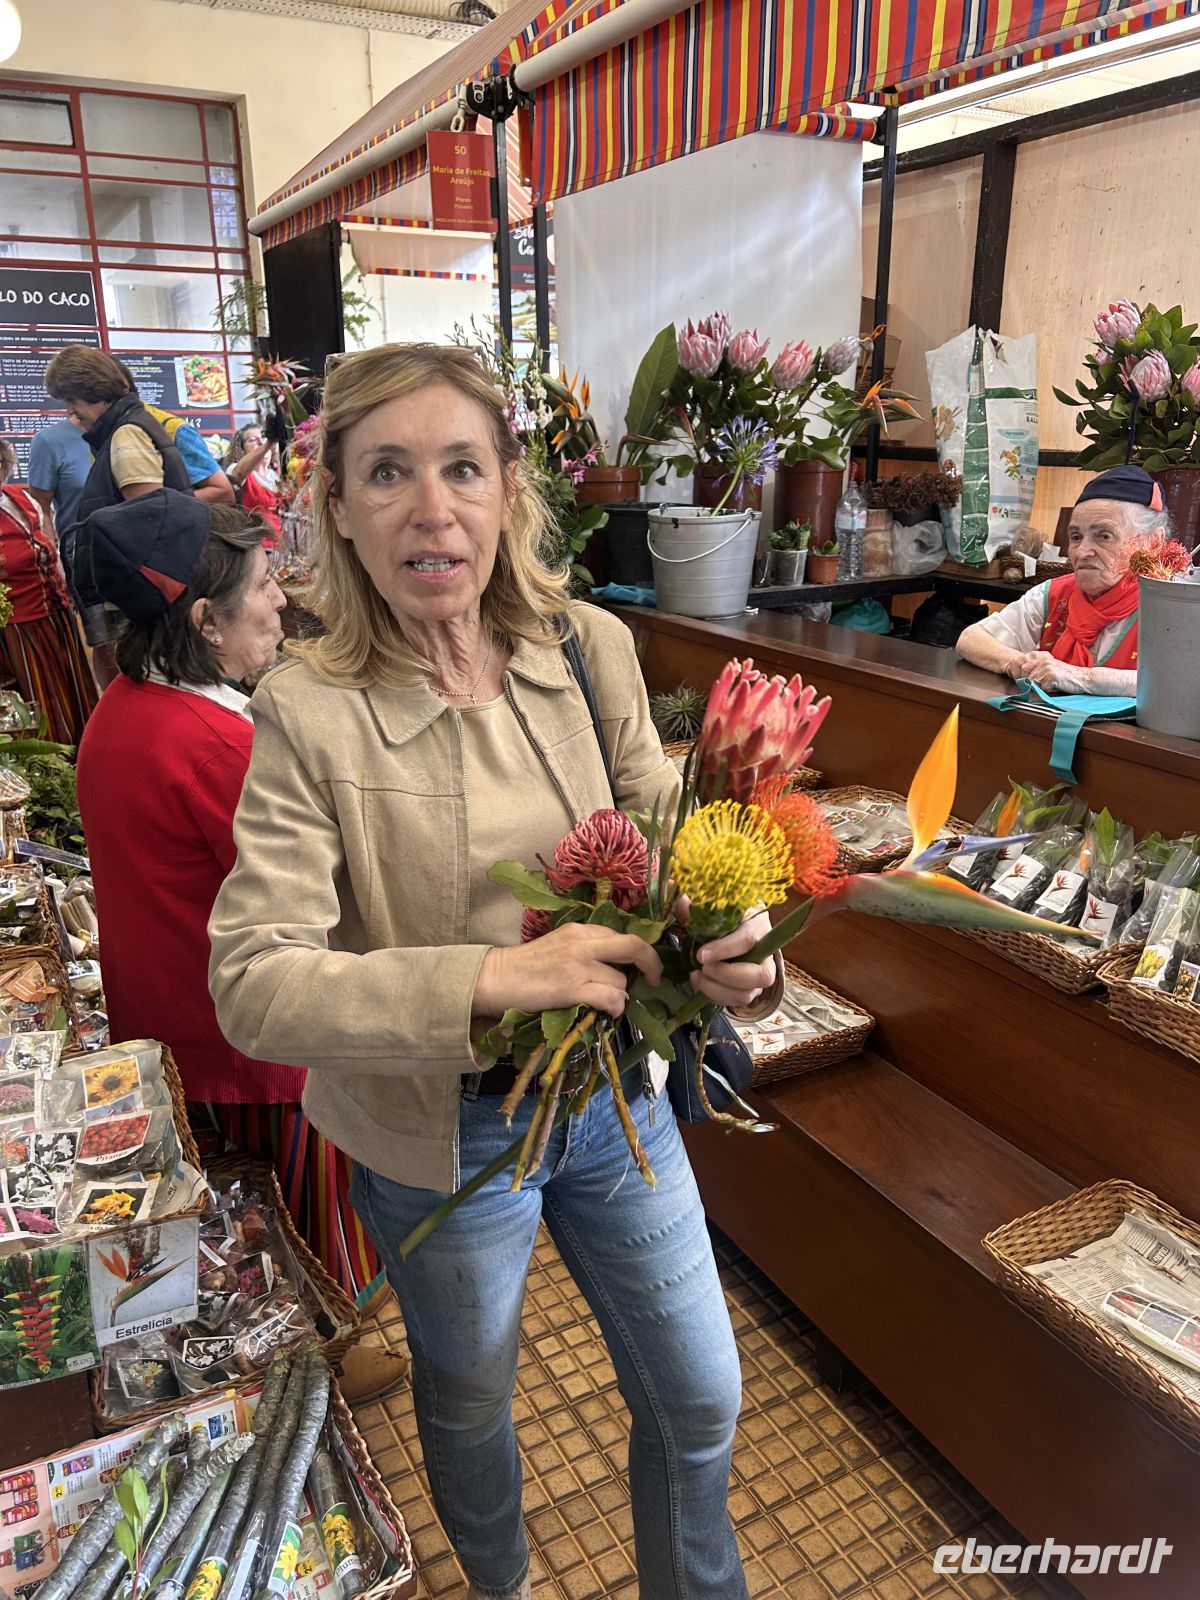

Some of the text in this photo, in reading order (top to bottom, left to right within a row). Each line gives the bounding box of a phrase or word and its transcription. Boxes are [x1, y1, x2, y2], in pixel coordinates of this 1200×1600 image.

[454, 145, 467, 155] 50
[432, 165, 491, 177] Maria de Freitas
[450, 176, 474, 187] Araújo
[518, 238, 535, 255] Ca
[22, 291, 43, 304] DO
[49, 292, 90, 306] CACO
[116, 1316, 173, 1339] Estrelícia
